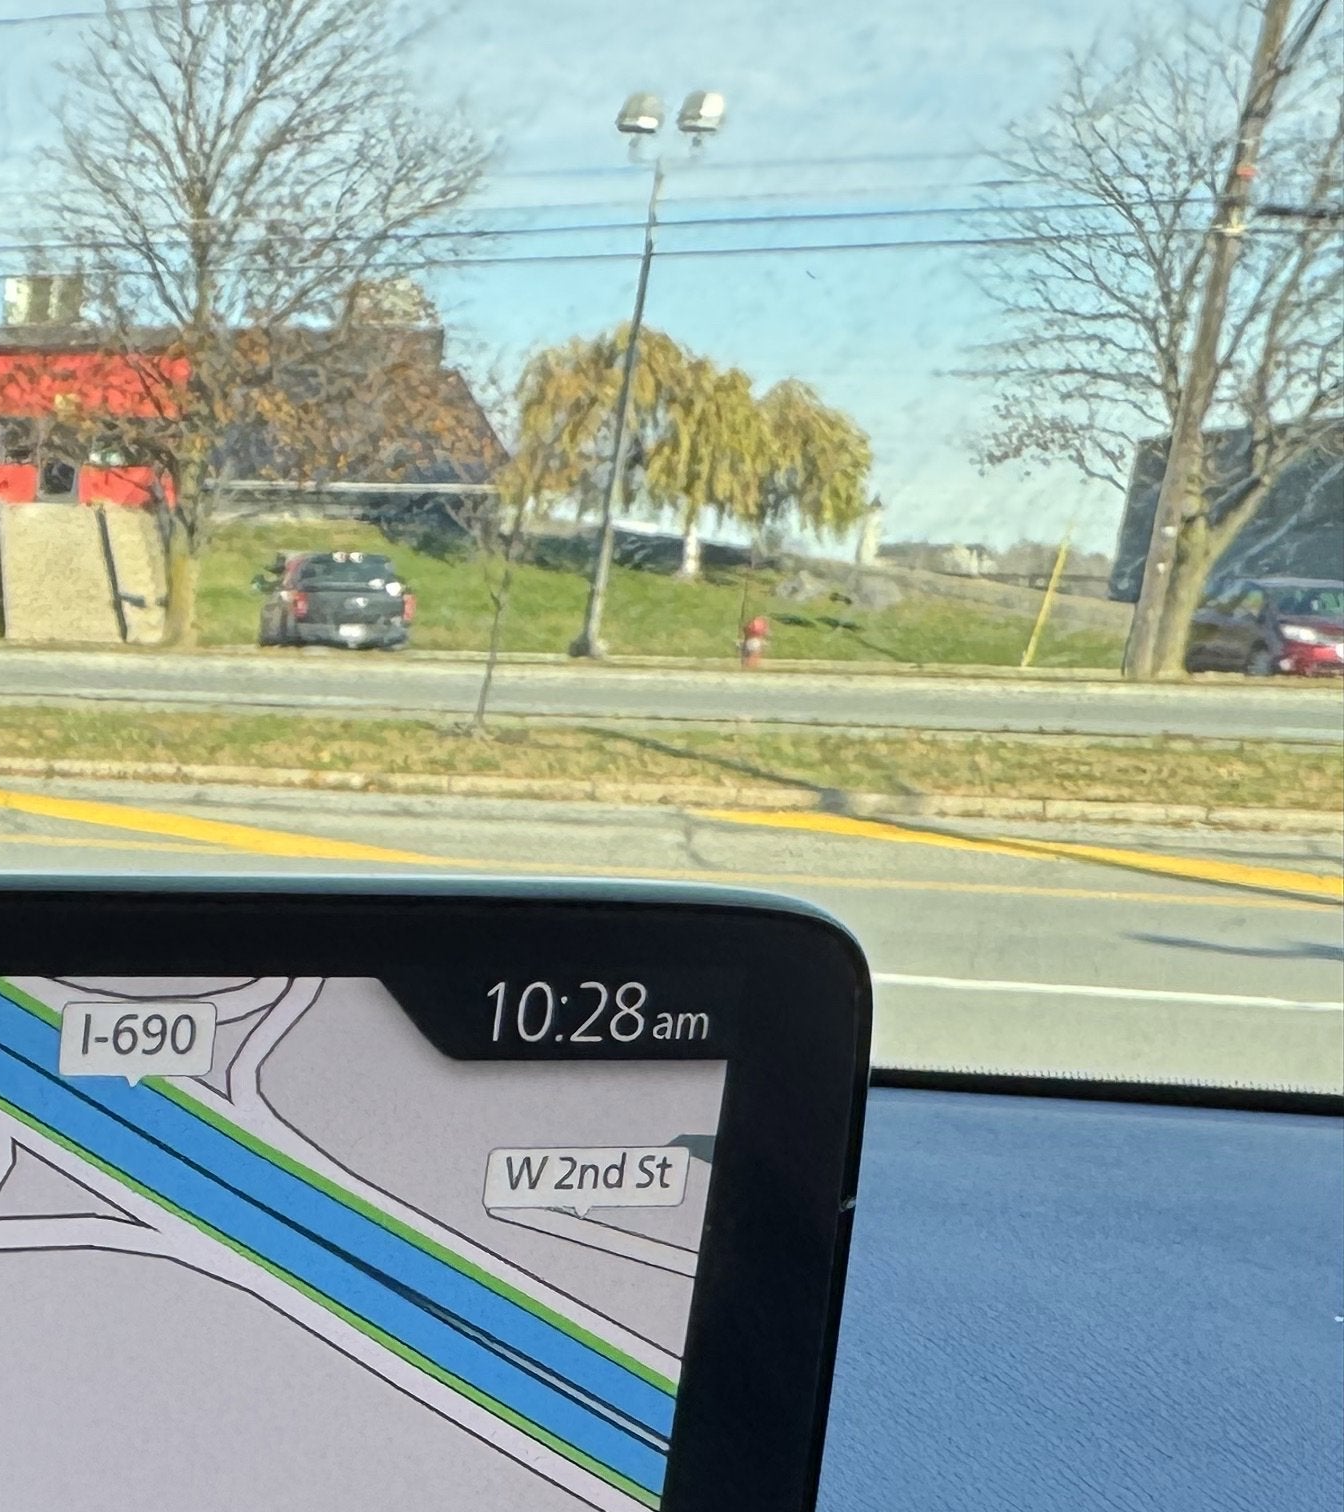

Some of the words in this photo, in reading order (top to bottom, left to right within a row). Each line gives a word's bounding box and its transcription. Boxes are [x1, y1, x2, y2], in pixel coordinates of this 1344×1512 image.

[82, 1013, 197, 1056] I-690
[504, 1156, 548, 1190] W
[553, 1151, 627, 1190] 2nd
[635, 1154, 673, 1189] St
